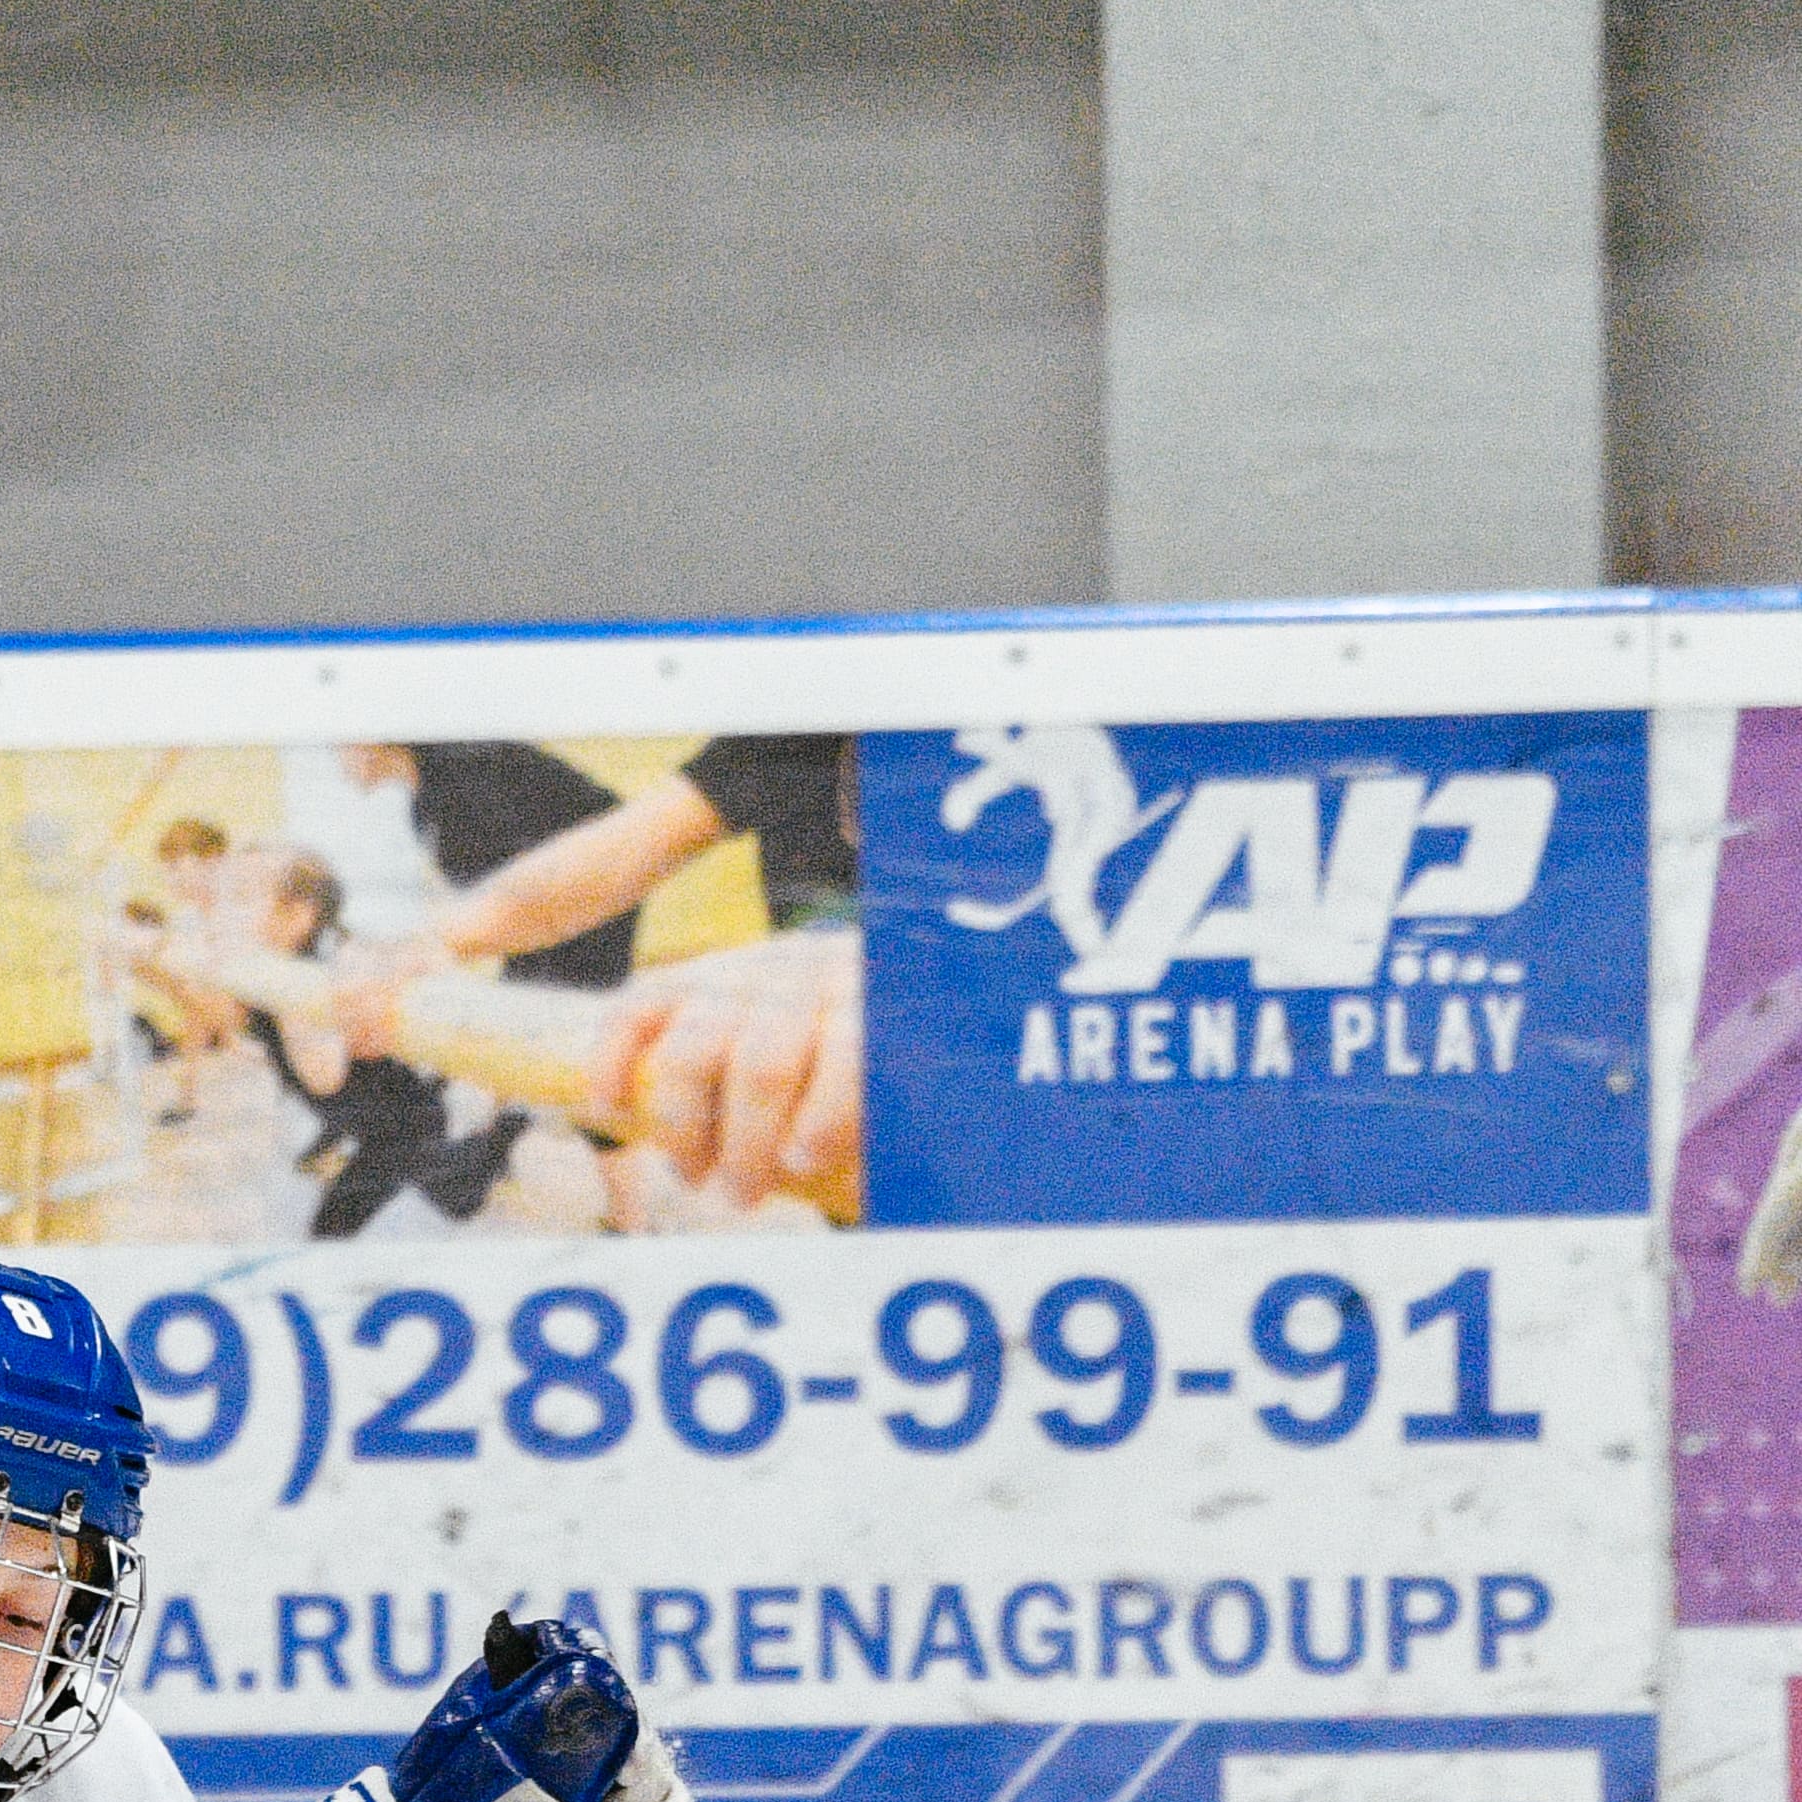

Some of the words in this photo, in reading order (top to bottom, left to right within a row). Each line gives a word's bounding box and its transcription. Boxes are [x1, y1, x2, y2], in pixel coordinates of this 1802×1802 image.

[1016, 995, 1296, 1084] ARENA
[1328, 992, 1529, 1078] PLAY
[0, 1292, 54, 1341] 8
